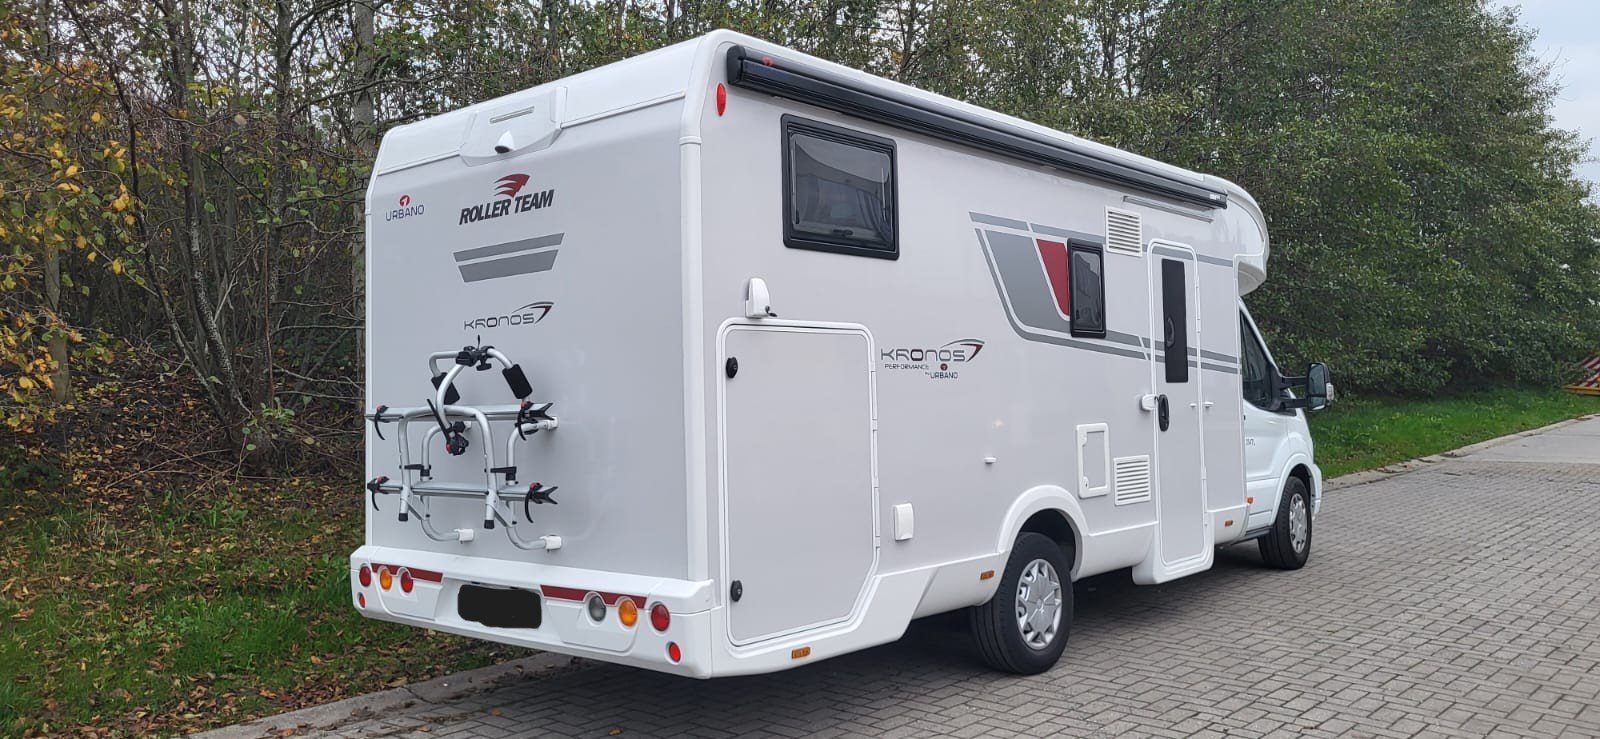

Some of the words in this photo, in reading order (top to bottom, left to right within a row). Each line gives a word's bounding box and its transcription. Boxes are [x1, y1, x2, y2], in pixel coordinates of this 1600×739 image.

[385, 204, 425, 221] URBANO
[459, 198, 511, 225] ROLLER
[514, 189, 554, 213] TEAM
[464, 312, 534, 330] KRONOS
[881, 348, 965, 362] KRONOS
[930, 371, 958, 379] URBANO
